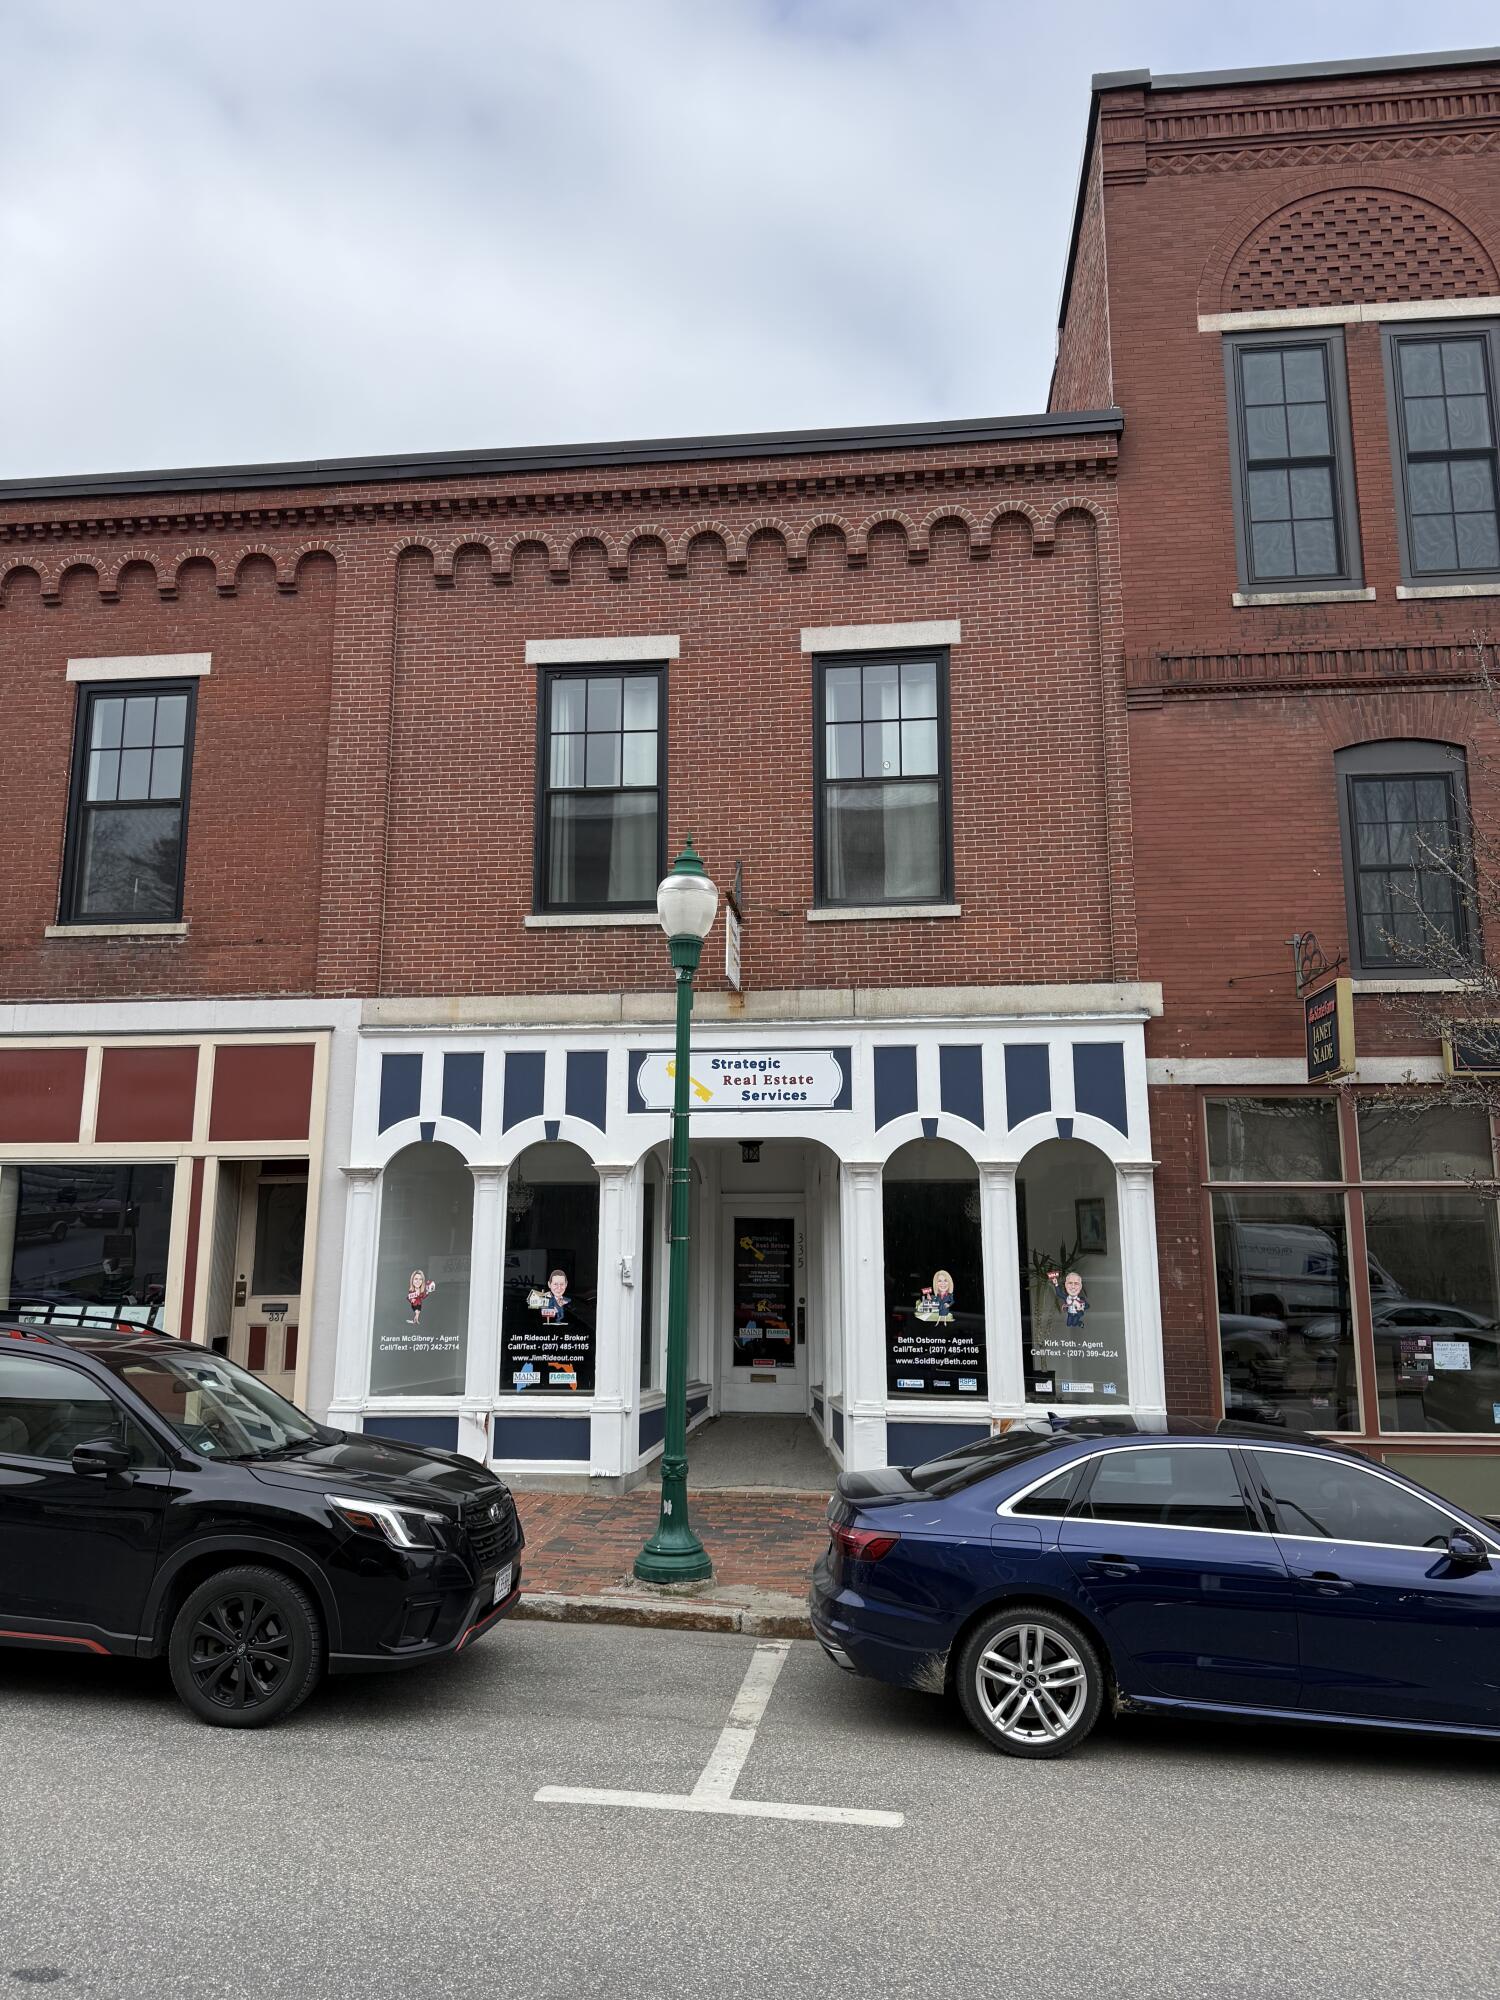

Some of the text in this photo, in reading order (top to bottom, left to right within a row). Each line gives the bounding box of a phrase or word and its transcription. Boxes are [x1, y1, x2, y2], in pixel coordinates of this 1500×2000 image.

[1312, 1021, 1332, 1046] JANEY
[1313, 1043, 1334, 1065] SLADE
[711, 1058, 781, 1072] Strategic
[723, 1074, 814, 1086] Real Estate
[741, 1089, 807, 1101] Services
[268, 1312, 285, 1322] 337
[740, 1328, 762, 1336] MAINE
[402, 1335, 434, 1343] McGibney
[439, 1335, 459, 1343] Agent
[952, 1337, 973, 1345] Agent
[413, 1344, 430, 1352] (207)
[542, 1343, 559, 1351] (207)
[1082, 1340, 1103, 1349] Agent
[929, 1346, 947, 1354] (207)
[948, 1346, 979, 1354] 485-1106
[1067, 1350, 1085, 1358] (207)
[896, 1357, 978, 1366] www.SoldBuyBeth.com
